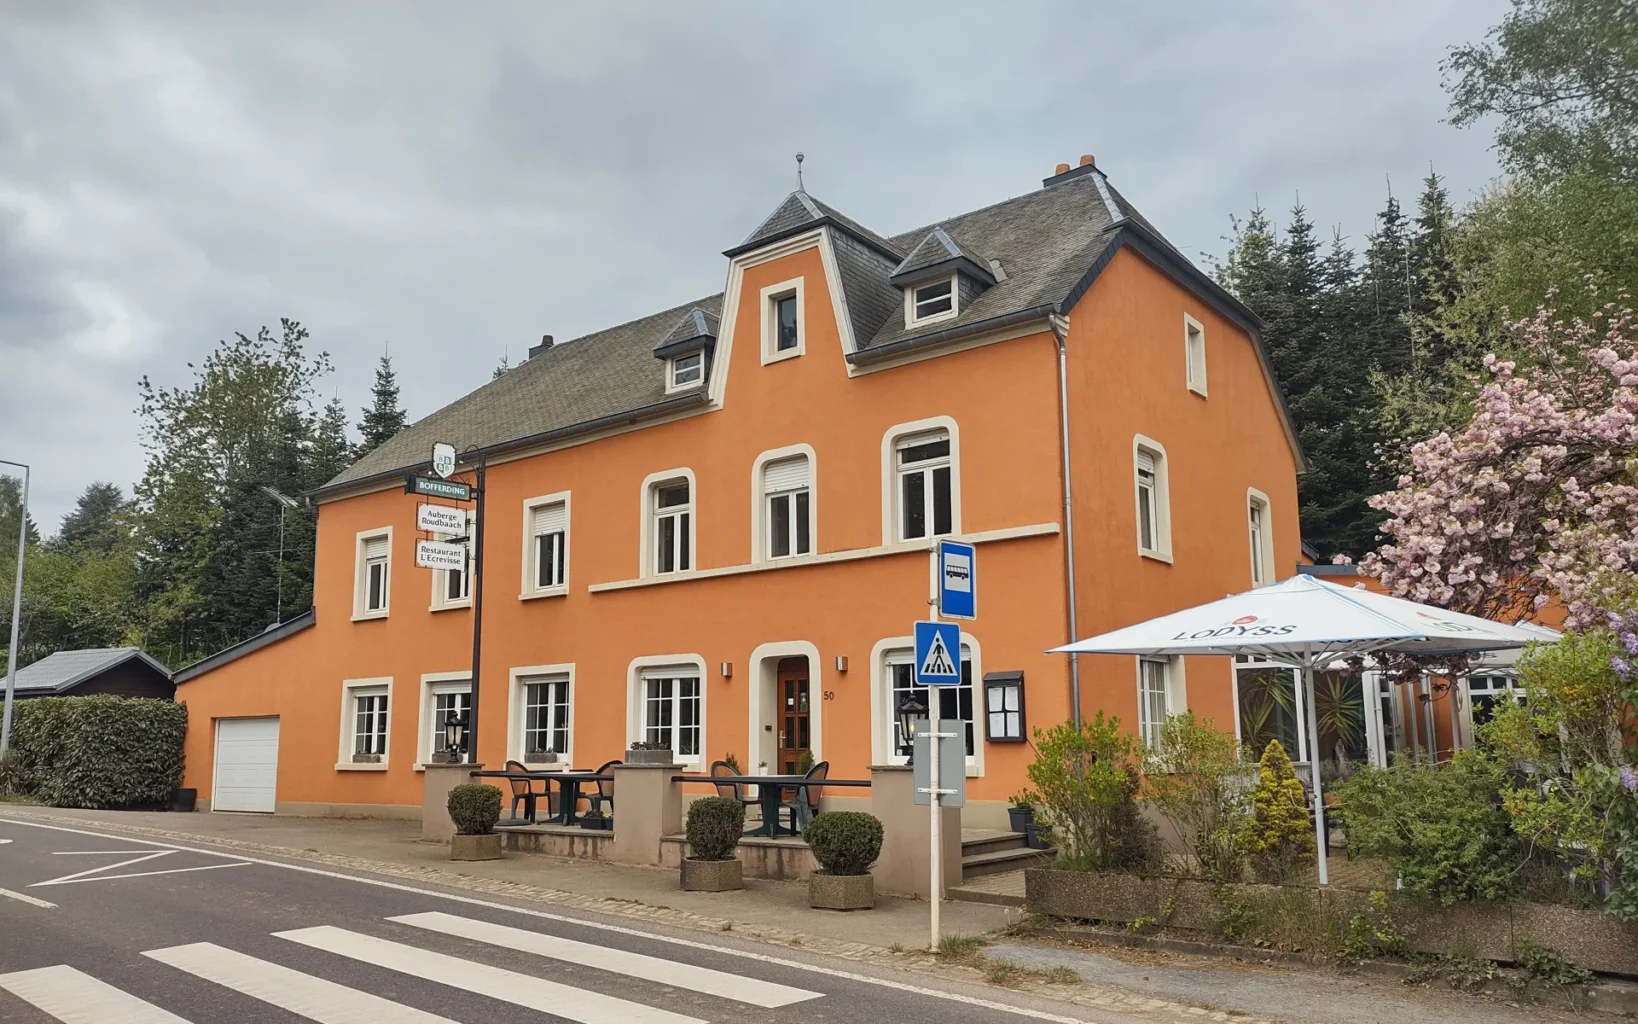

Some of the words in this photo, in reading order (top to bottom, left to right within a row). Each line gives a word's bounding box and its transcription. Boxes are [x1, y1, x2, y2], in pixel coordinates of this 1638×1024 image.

[419, 481, 465, 495] BOFFERDING
[427, 510, 457, 521] Auberge
[421, 517, 462, 529] Roudbaach
[421, 545, 461, 557] Restaurant
[420, 553, 461, 565] L'Ecrevisse
[1170, 625, 1297, 641] LODYSS
[823, 690, 835, 701] 50
